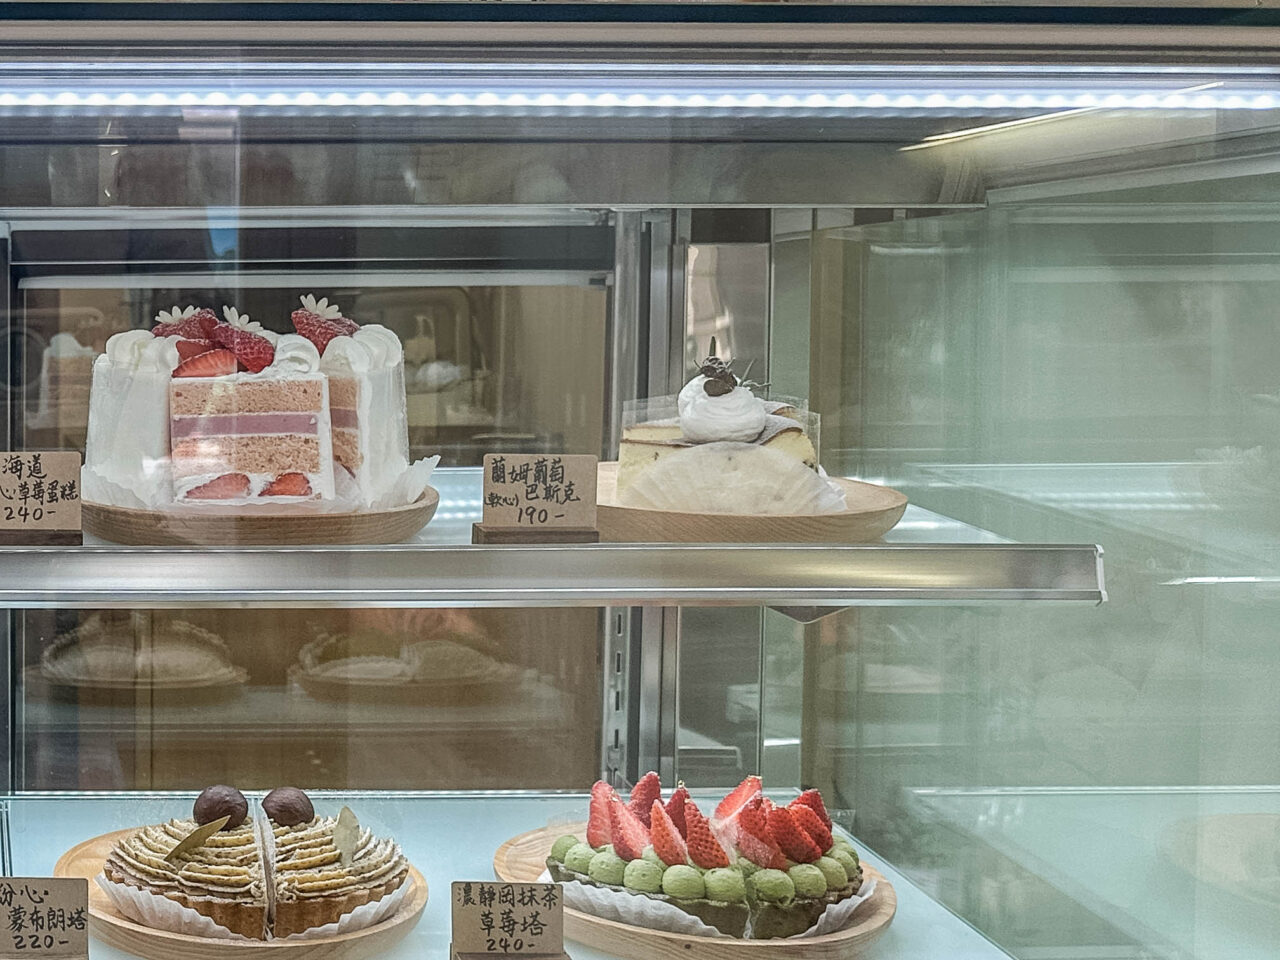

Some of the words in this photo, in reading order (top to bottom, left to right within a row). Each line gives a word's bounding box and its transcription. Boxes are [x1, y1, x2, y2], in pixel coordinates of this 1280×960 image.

[525, 481, 581, 504] 巴斯克
[6, 905, 88, 933] 蒙布朗塔
[480, 908, 547, 938] 草莓塔
